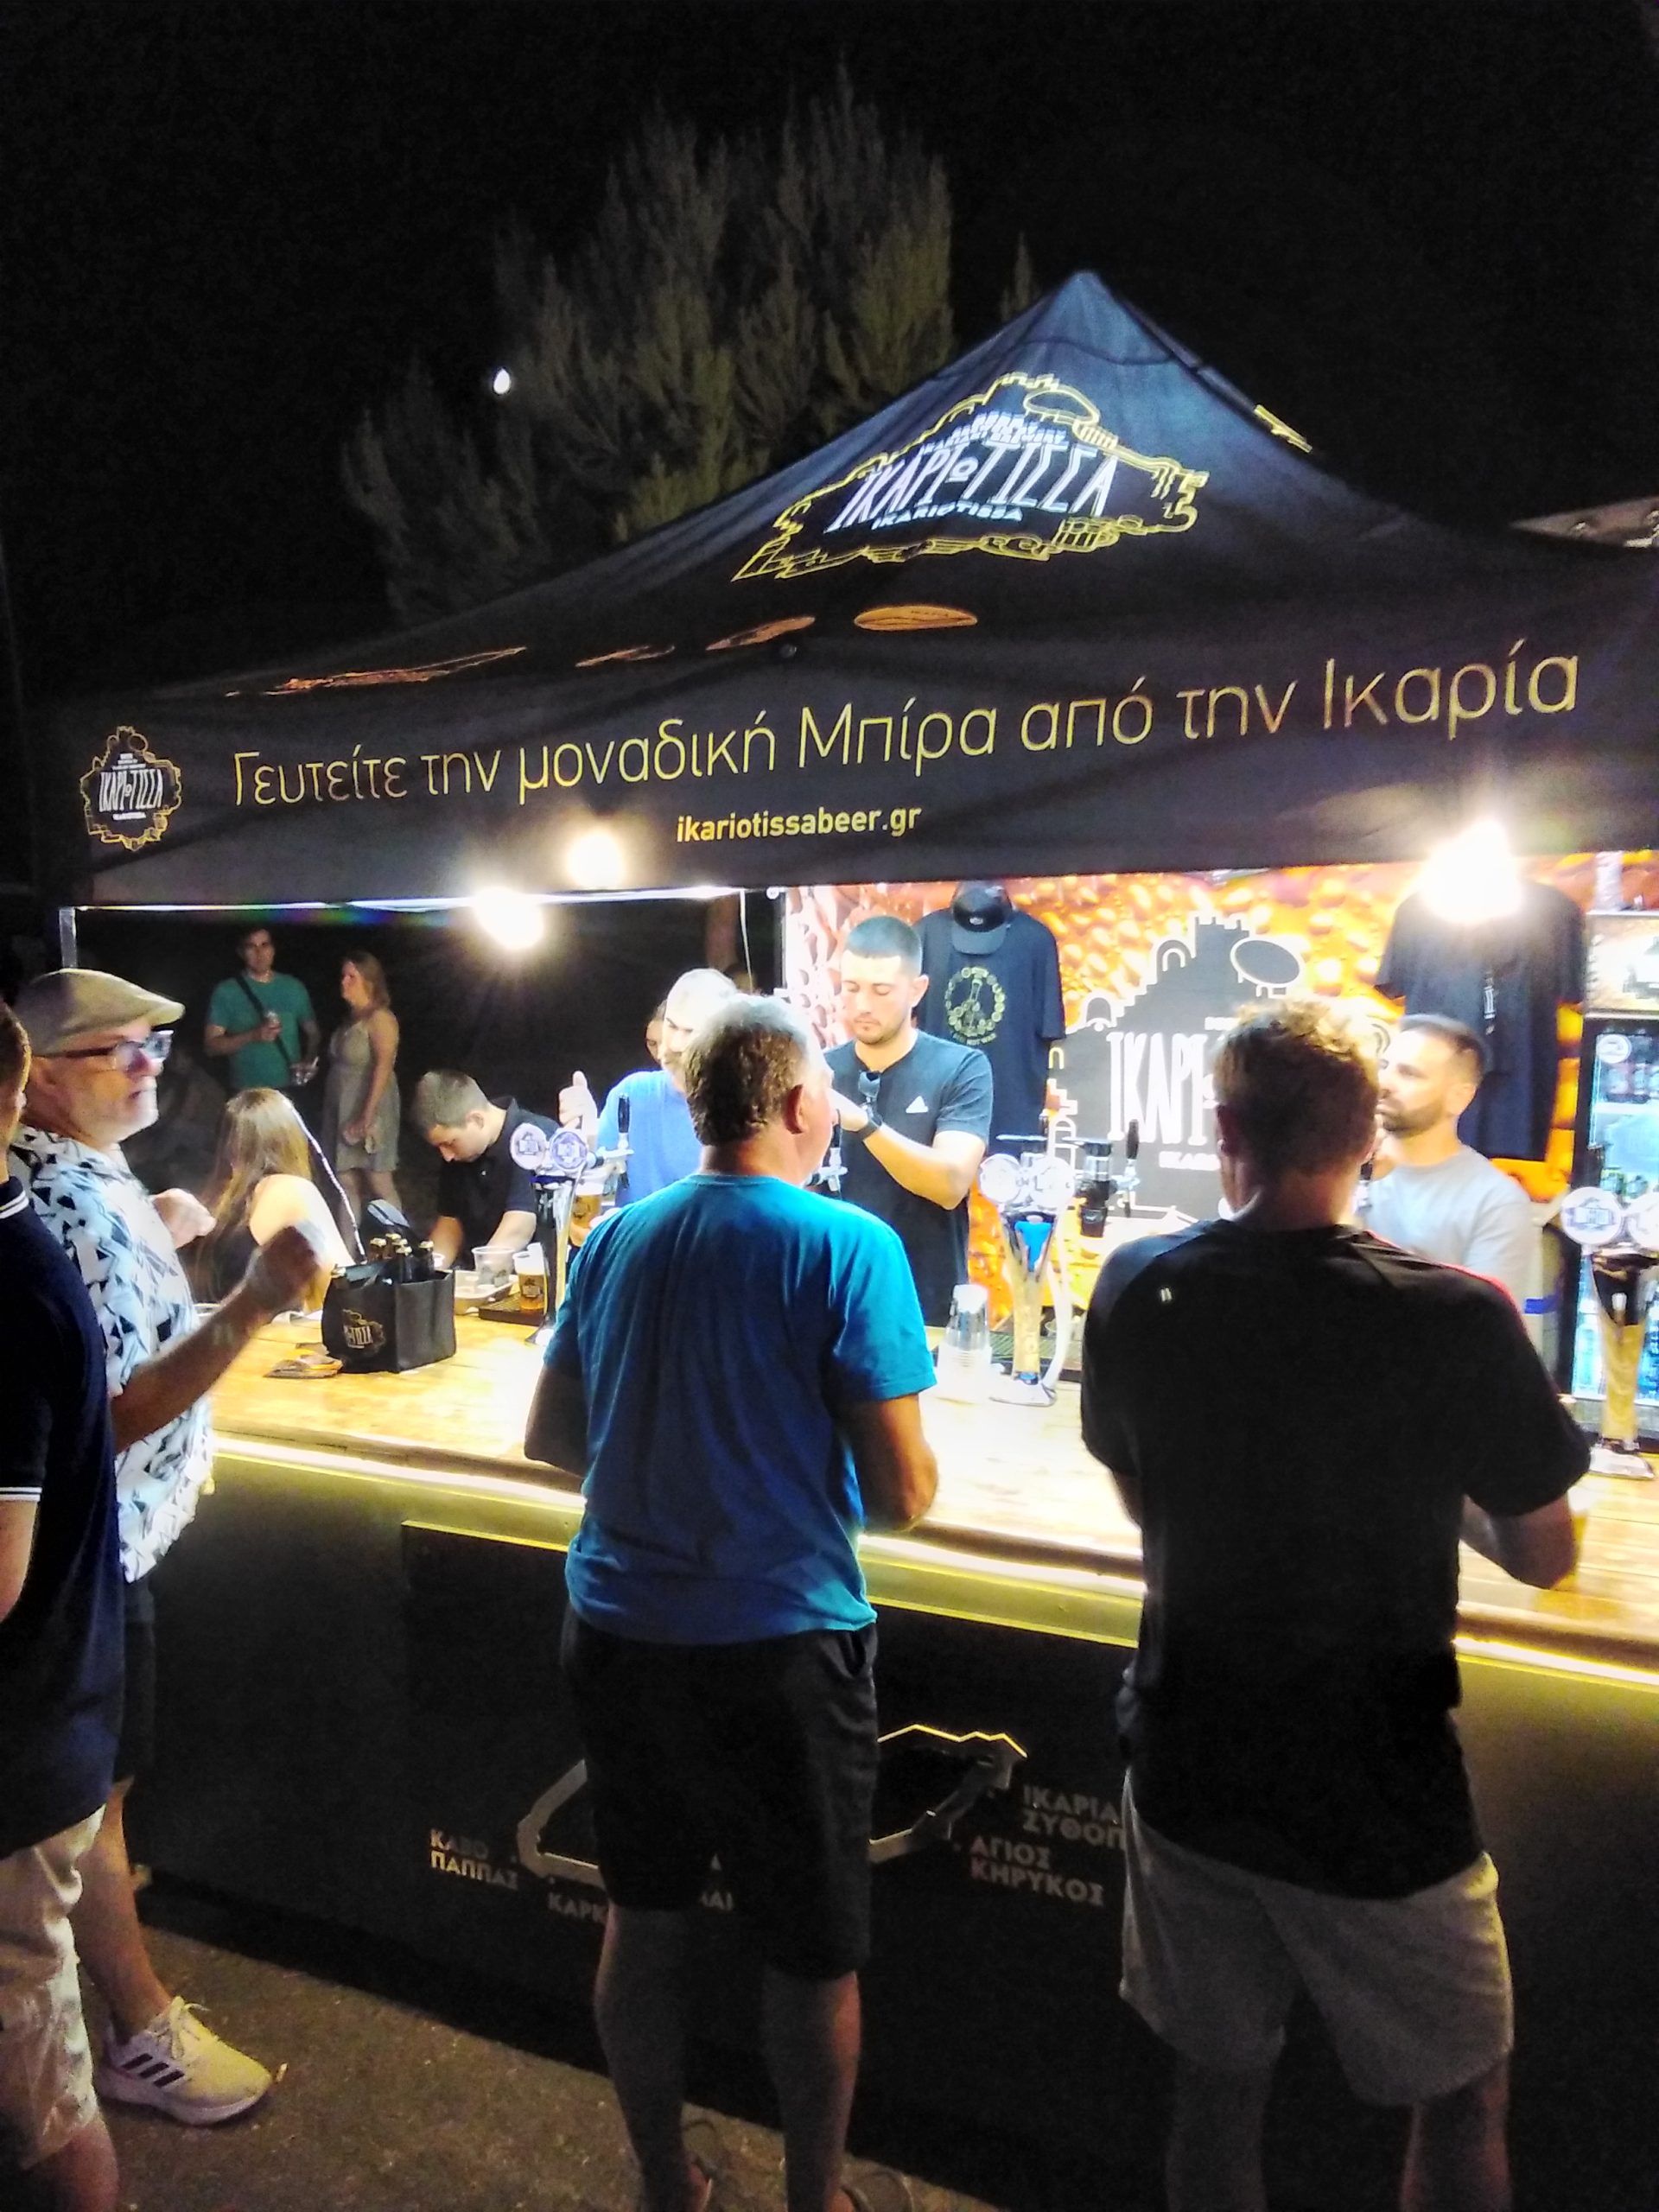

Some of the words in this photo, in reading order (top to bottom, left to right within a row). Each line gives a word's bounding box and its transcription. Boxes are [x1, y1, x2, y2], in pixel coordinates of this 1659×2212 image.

[870, 501, 1023, 531] IKARIOTISSA
[233, 743, 408, 806] Γευτείτε
[420, 749, 502, 796] την
[518, 710, 777, 805] μοναδική
[798, 696, 999, 778] Μπίρα
[1020, 674, 1154, 753] από
[1176, 679, 1299, 740] την
[1323, 636, 1580, 741] Ικαρία
[676, 805, 924, 844] ikariotissabeer.gr
[1022, 1808, 1126, 1850] ΖΥΘΟΠ
[429, 1849, 519, 1891] ΠΑΠΠΑΣ
[969, 1834, 1052, 1870] ΑΓΙΟΣ
[969, 1857, 1104, 1908] ΚΗΡΥΚΟΣ
